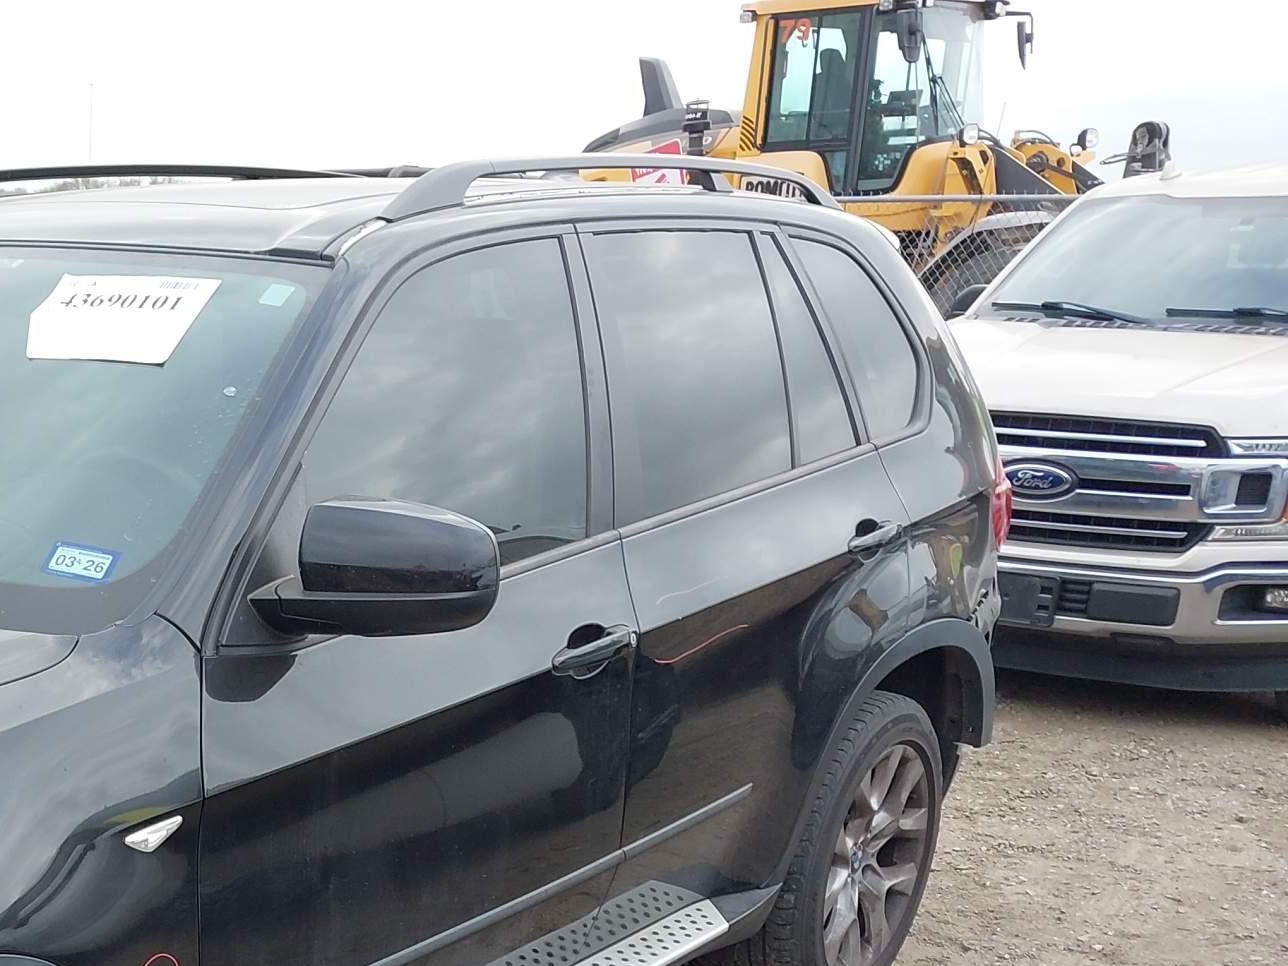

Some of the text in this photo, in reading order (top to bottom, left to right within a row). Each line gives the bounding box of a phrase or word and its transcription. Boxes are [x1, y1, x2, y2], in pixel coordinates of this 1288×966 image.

[779, 17, 811, 44] 79
[60, 293, 184, 310] 43690101
[1012, 469, 1053, 489] Ford
[55, 554, 106, 574] 03 26
